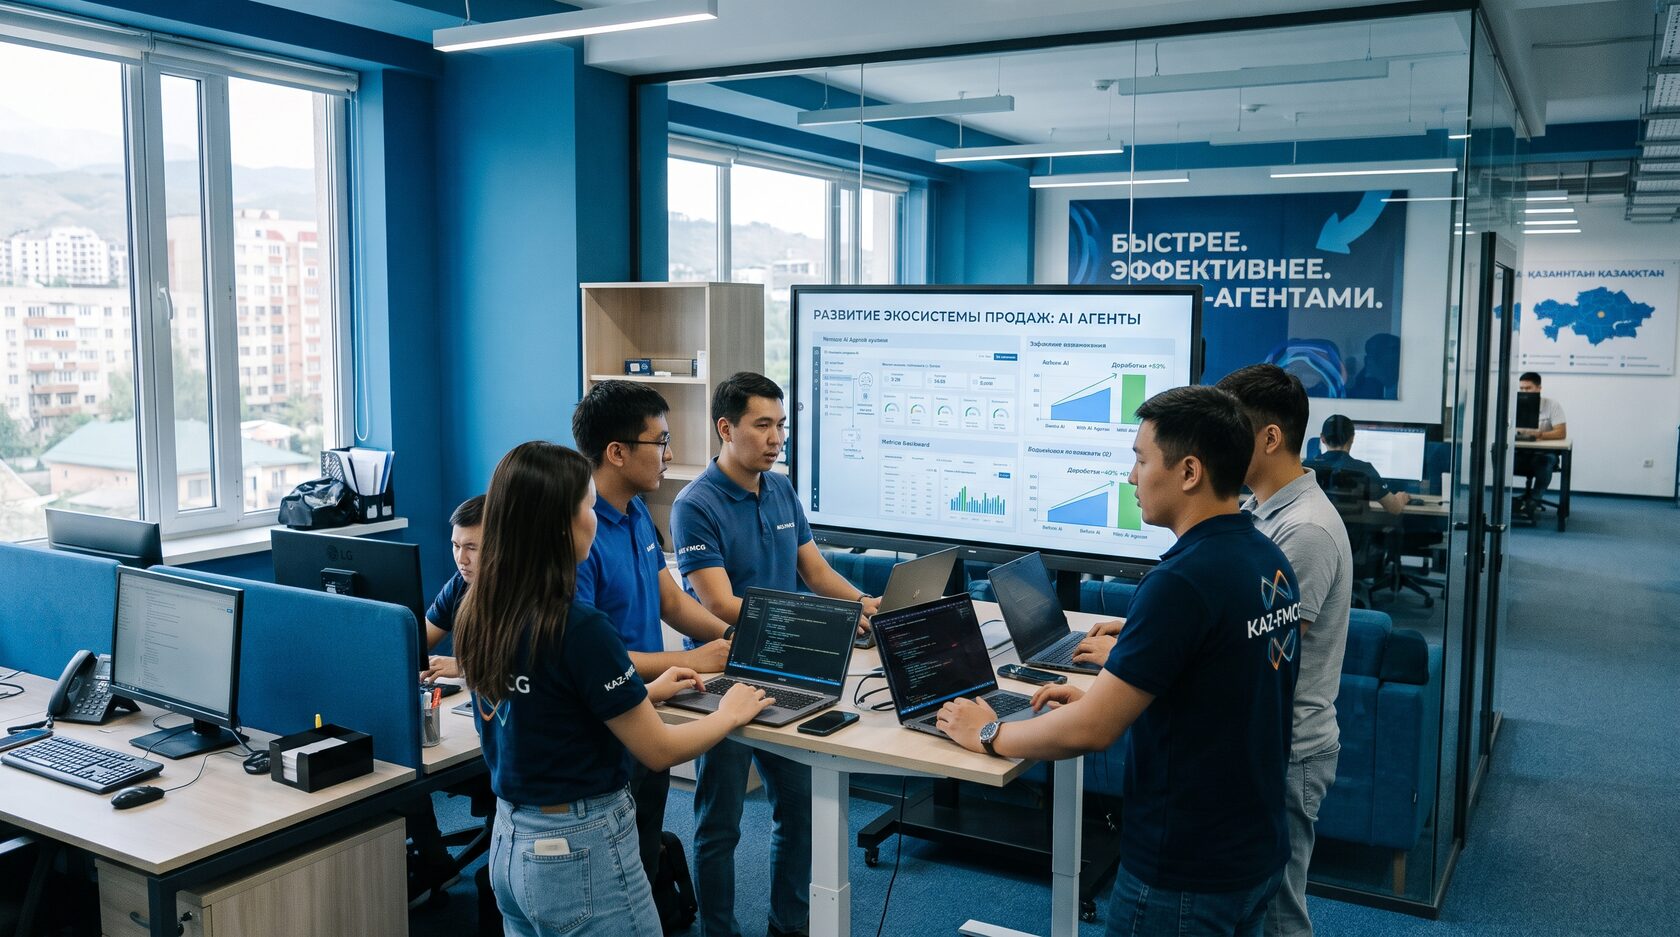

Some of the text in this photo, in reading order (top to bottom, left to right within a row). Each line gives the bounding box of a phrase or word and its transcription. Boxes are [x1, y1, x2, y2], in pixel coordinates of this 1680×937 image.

[1112, 231, 1248, 254] БЫСТРЕЕ.
[1110, 258, 1331, 281] ЭФФЕКТИВНЕЕ.
[813, 309, 1141, 325] РАЗВИТИЕ ЭКОСИСТЕМЫ ПРОДАЖ: AI АГЕНТЫ
[340, 550, 353, 560] LG
